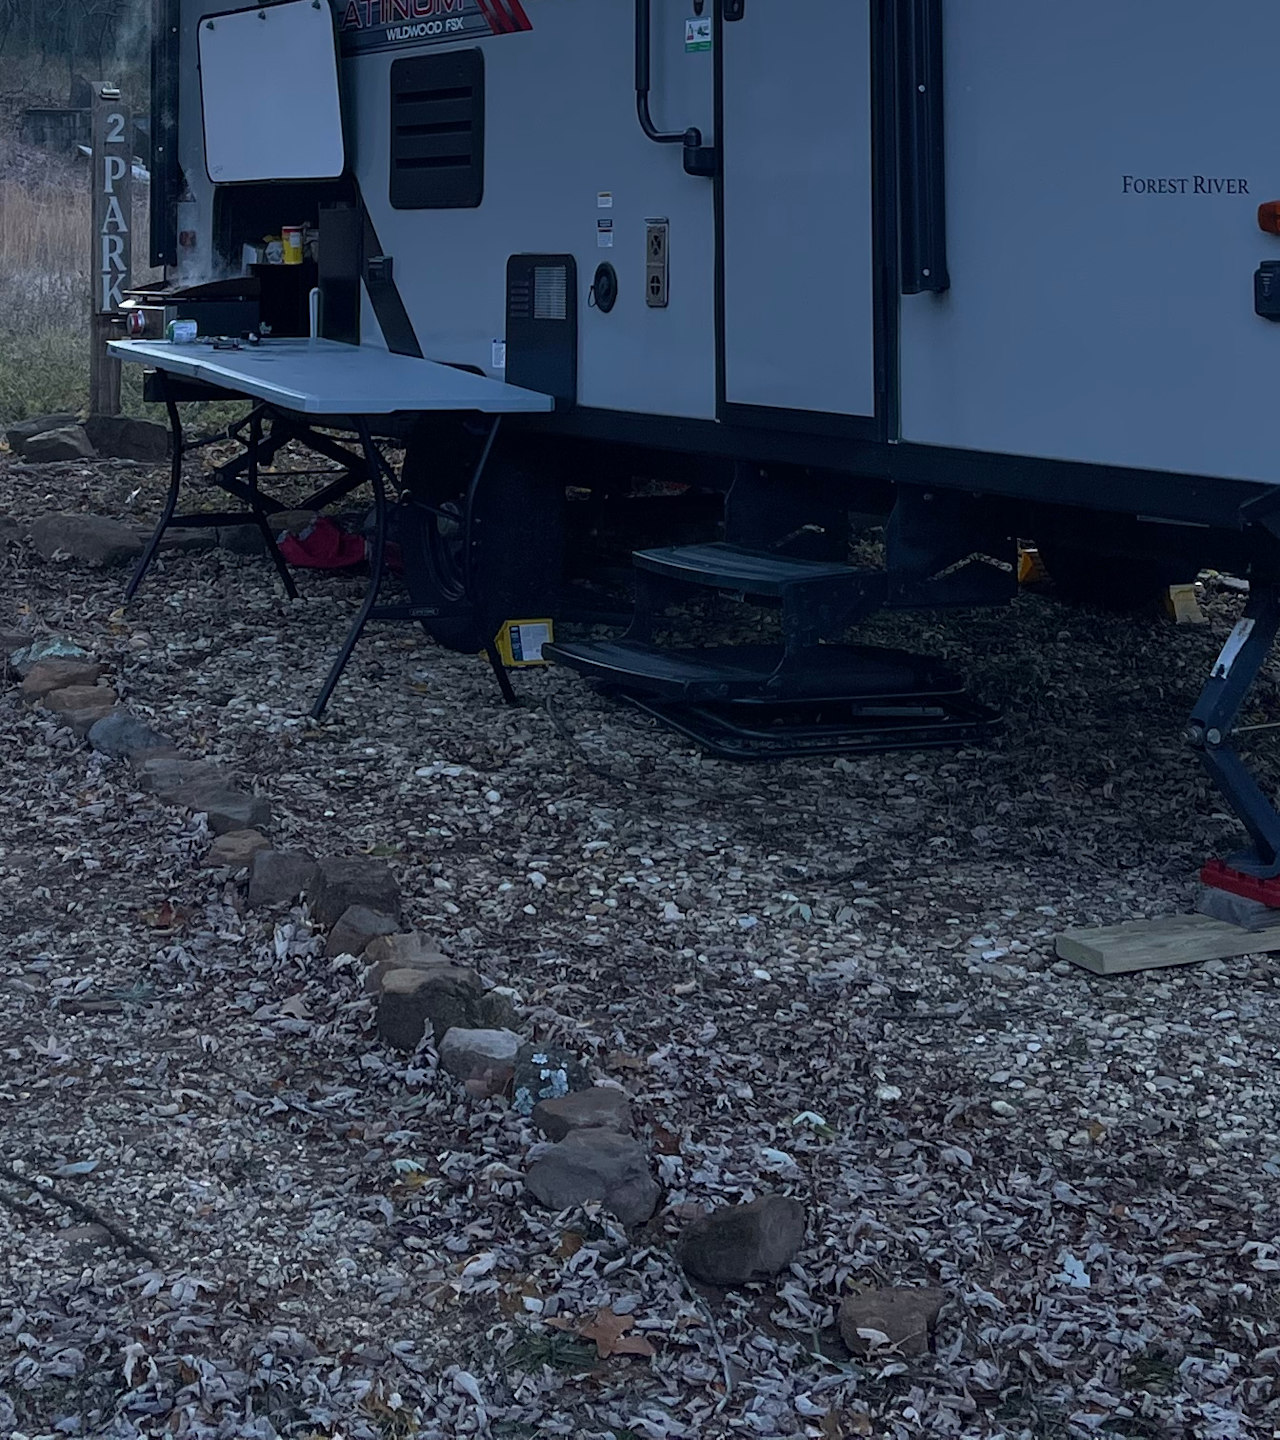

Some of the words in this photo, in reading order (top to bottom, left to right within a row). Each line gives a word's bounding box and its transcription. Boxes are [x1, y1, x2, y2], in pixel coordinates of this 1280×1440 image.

[386, 20, 443, 41] WILDWOOD
[445, 17, 464, 32] FSX
[106, 112, 126, 142] 2
[1121, 175, 1189, 194] FOREST
[1192, 175, 1250, 194] RIVER
[101, 155, 129, 312] PARK
